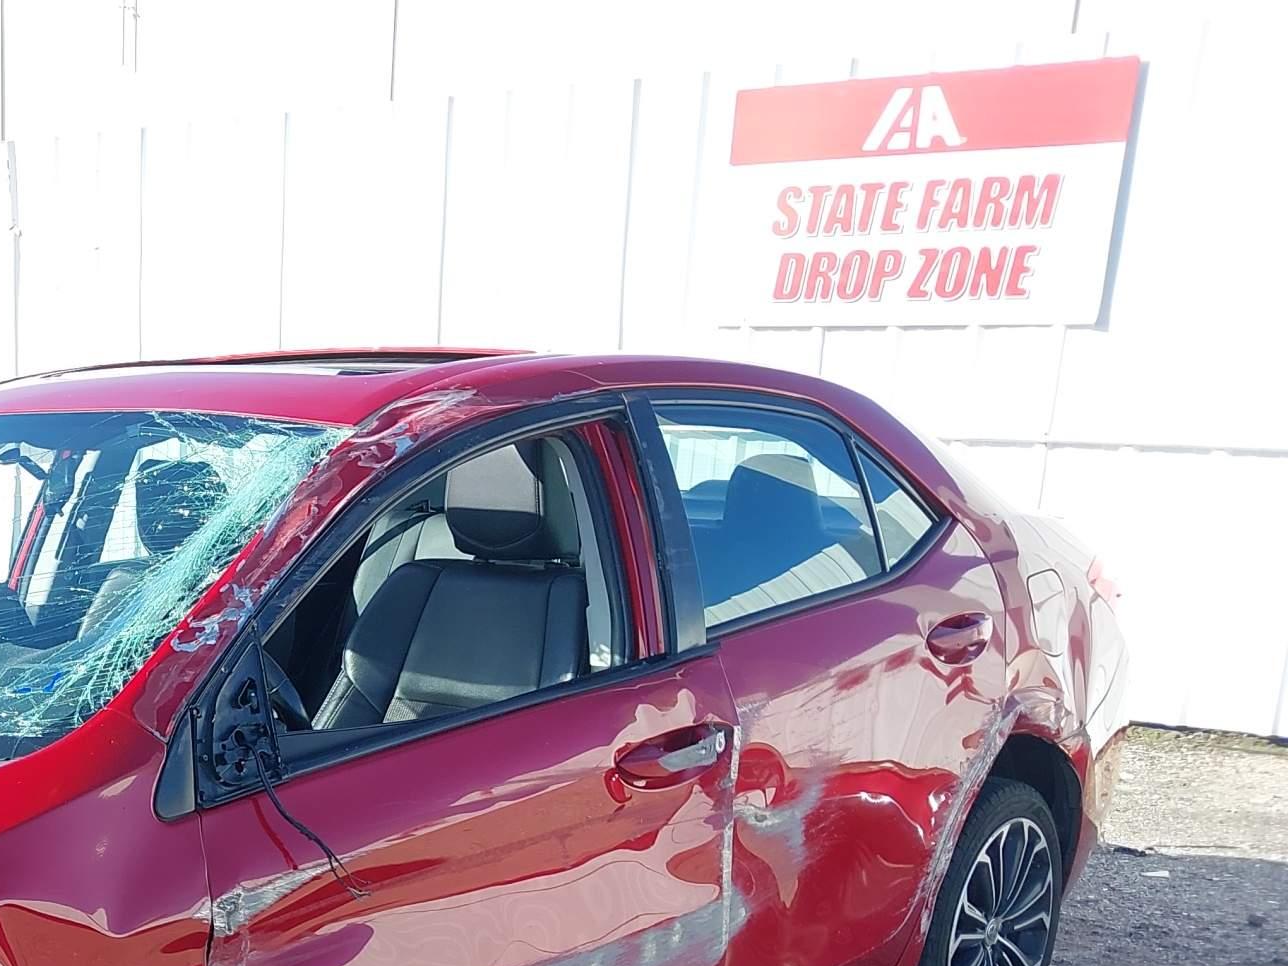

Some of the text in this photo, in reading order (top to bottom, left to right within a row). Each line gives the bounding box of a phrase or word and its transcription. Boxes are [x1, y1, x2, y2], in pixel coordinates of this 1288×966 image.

[772, 174, 1061, 236] STATE FARM
[773, 245, 1039, 301] DROP ZONE
